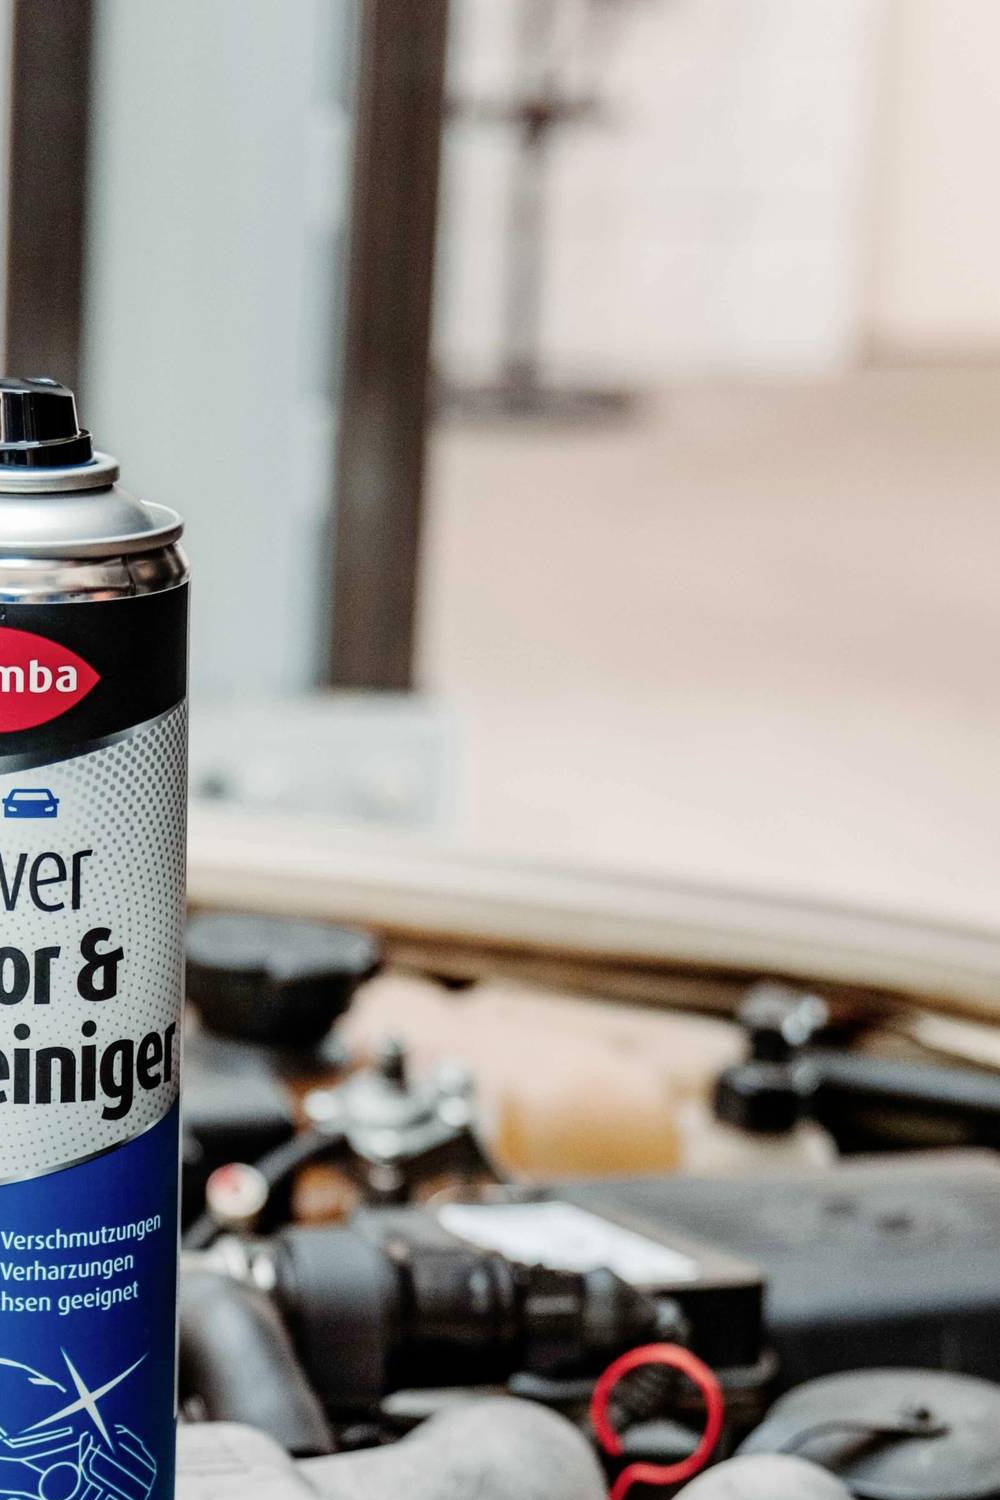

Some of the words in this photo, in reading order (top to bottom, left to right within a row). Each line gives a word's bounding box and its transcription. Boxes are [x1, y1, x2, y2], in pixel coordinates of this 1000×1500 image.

[76, 926, 125, 1002] &
[0, 1214, 161, 1251] Verschmutzungen
[0, 1254, 135, 1281] Verharzungen
[57, 1281, 139, 1316] geeignet
